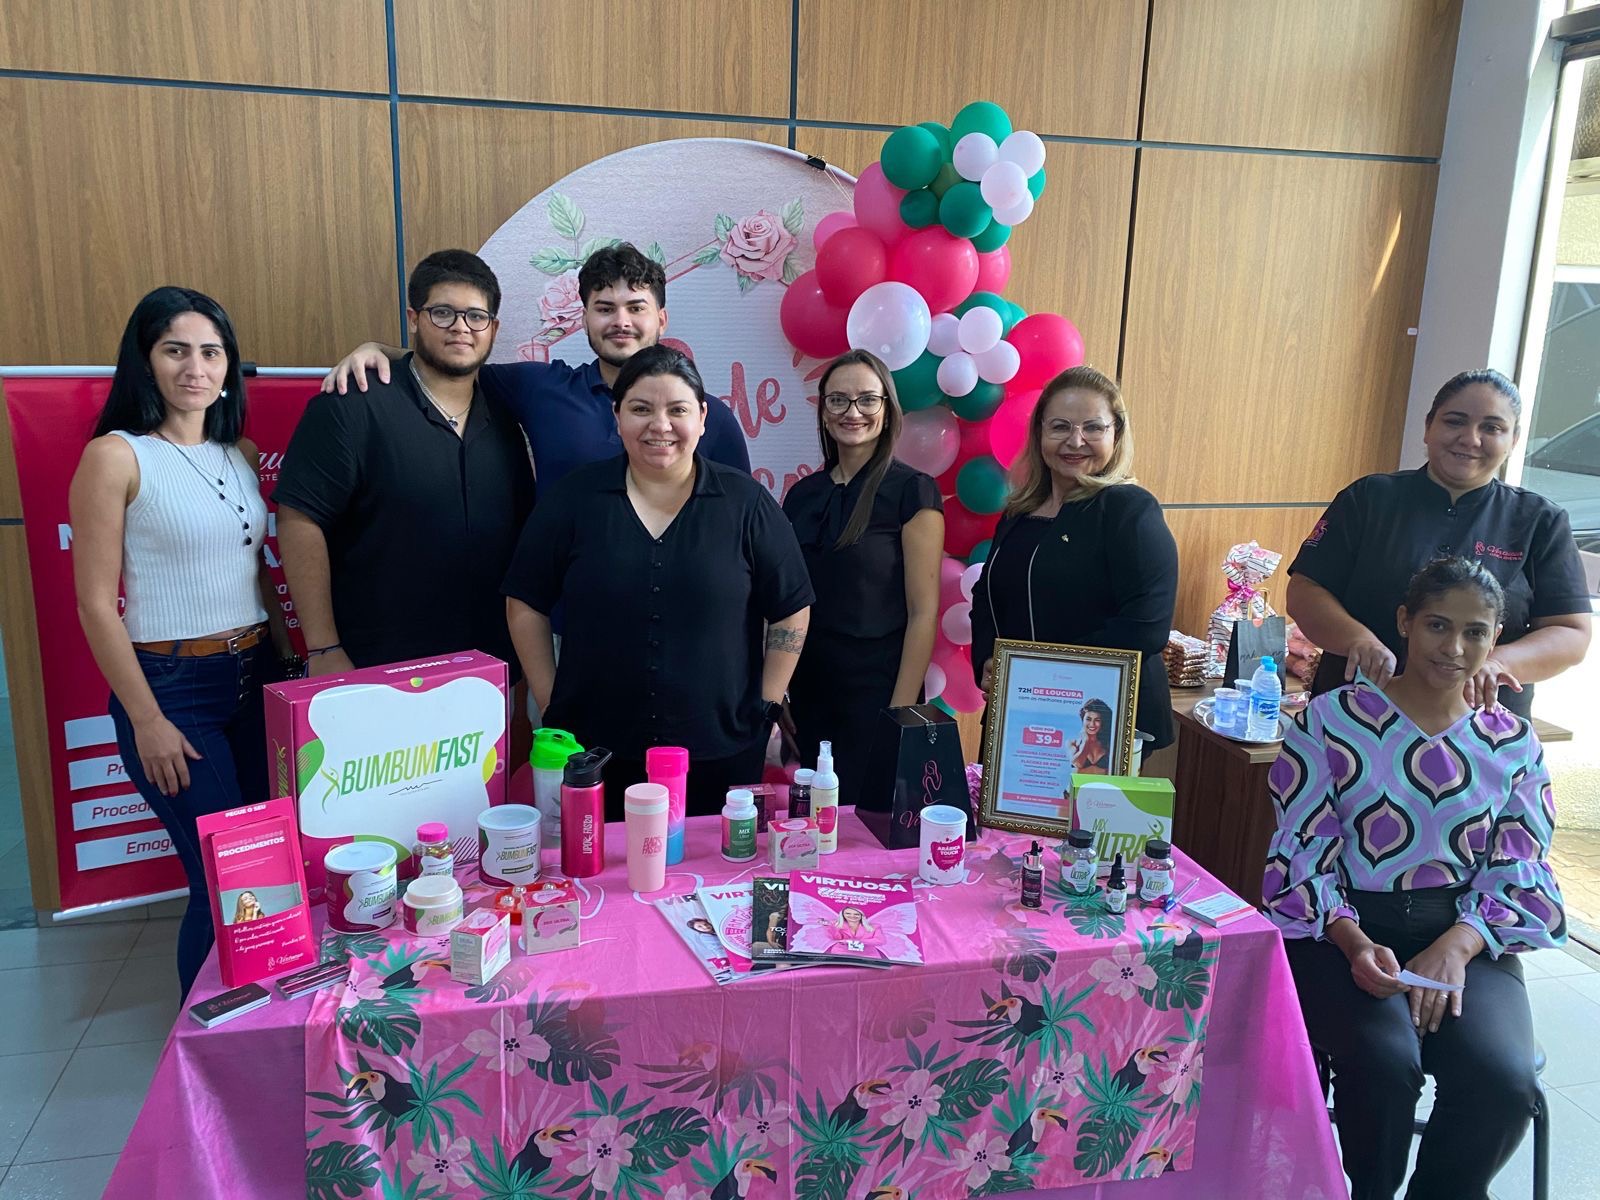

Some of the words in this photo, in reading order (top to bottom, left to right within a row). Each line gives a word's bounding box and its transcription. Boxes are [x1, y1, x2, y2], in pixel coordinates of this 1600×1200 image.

[1045, 689, 1082, 698] LOUCURA
[340, 730, 484, 796] BUMBUMFAST
[225, 808, 247, 818] PEGUE
[253, 804, 267, 812] SEU
[218, 836, 285, 858] PROCEDIMENTOS
[800, 874, 908, 893] VIRTUOSA
